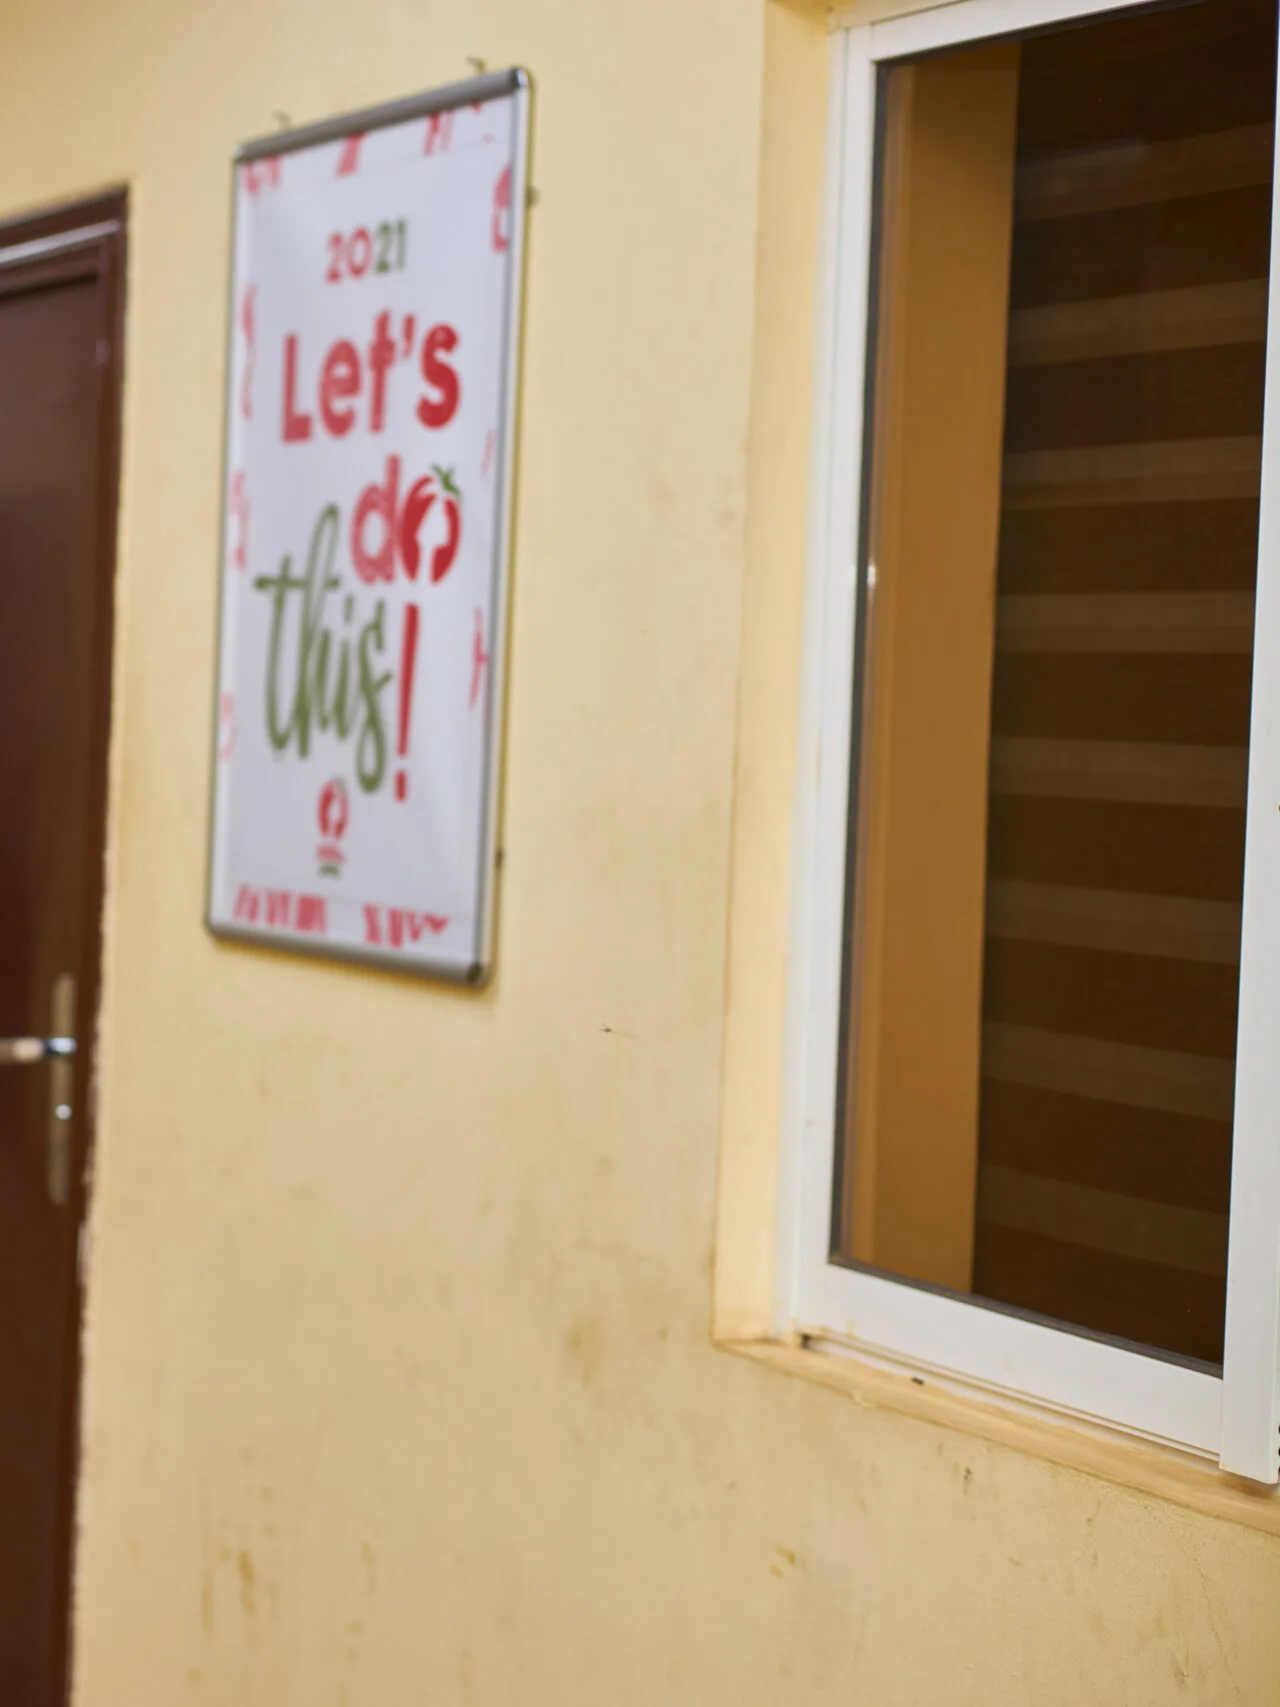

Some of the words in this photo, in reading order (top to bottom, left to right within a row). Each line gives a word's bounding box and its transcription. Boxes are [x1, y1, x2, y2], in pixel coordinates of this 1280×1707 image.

[326, 219, 407, 283] 2021
[281, 309, 460, 444] Let's
[351, 454, 461, 584] do
[253, 503, 419, 802] this!
